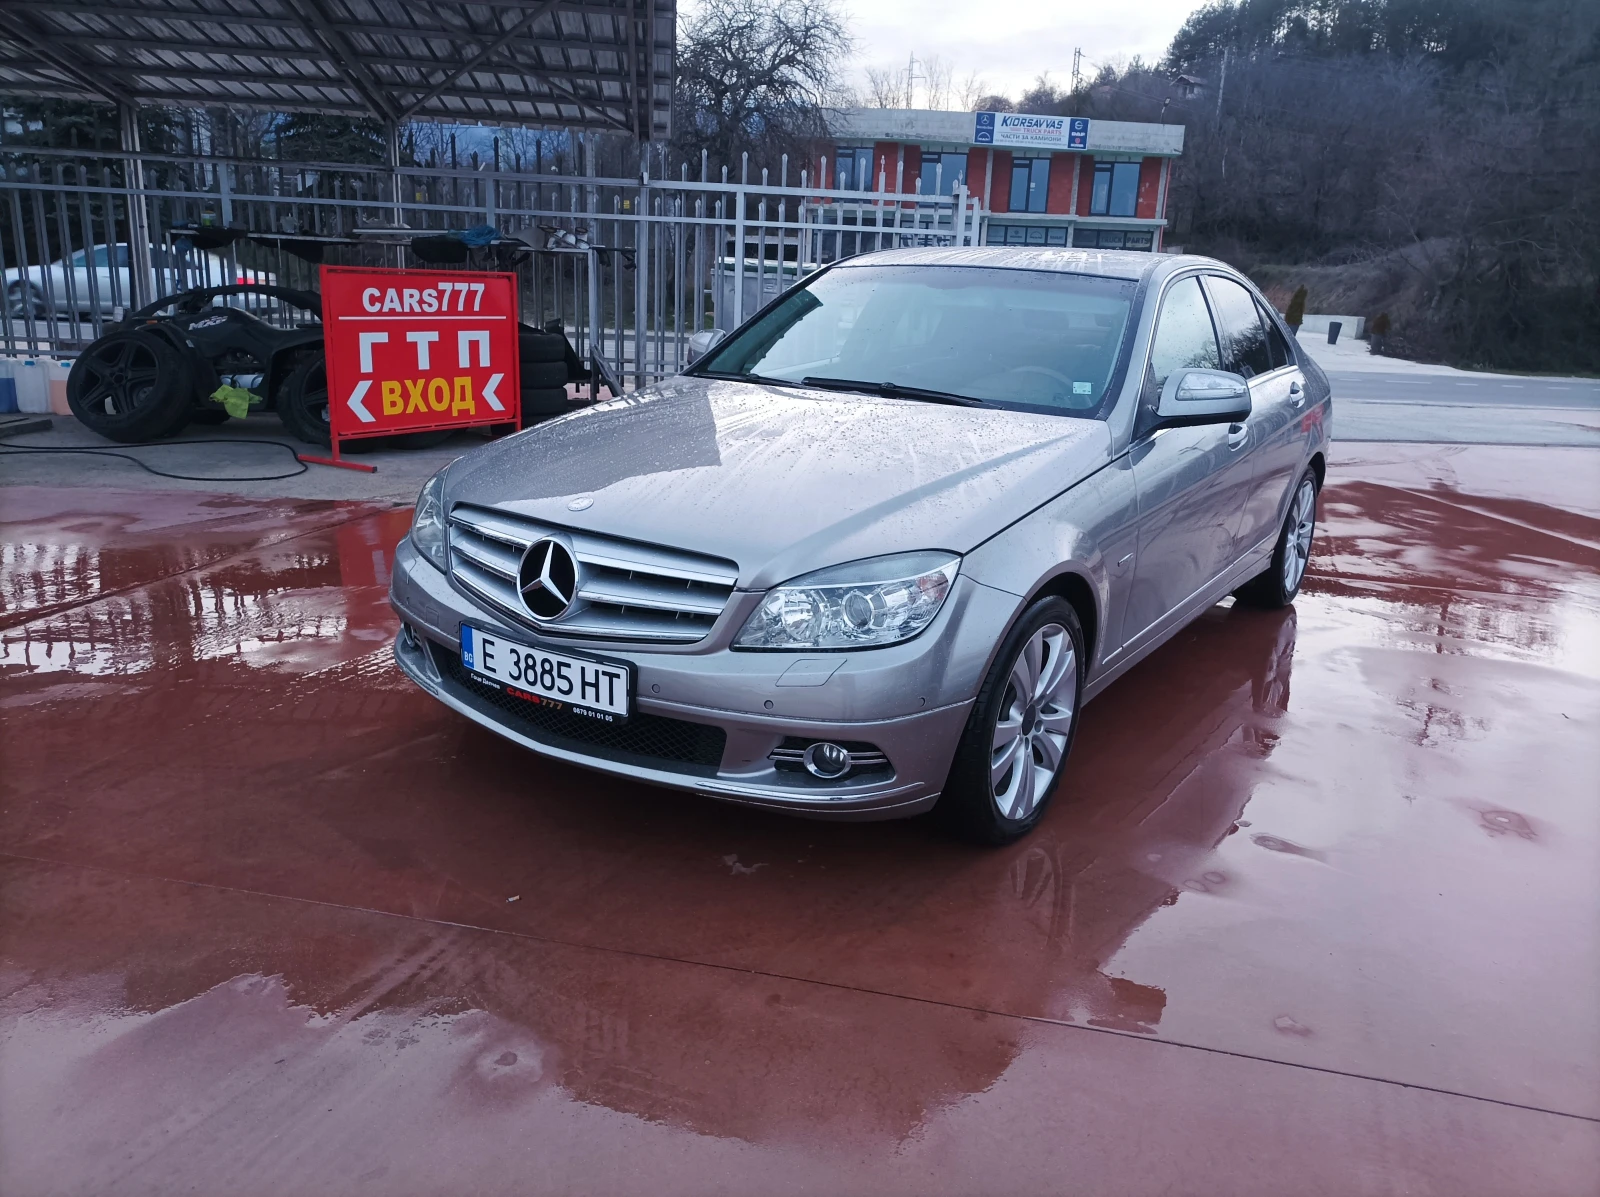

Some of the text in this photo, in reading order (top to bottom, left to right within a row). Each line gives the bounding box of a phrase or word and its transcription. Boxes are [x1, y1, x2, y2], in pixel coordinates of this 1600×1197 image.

[1126, 236, 1151, 245] PARTS
[362, 282, 485, 312] CARS777
[381, 376, 476, 417] ВХОД
[464, 651, 474, 663] BG
[482, 637, 621, 706] E 3885 HT
